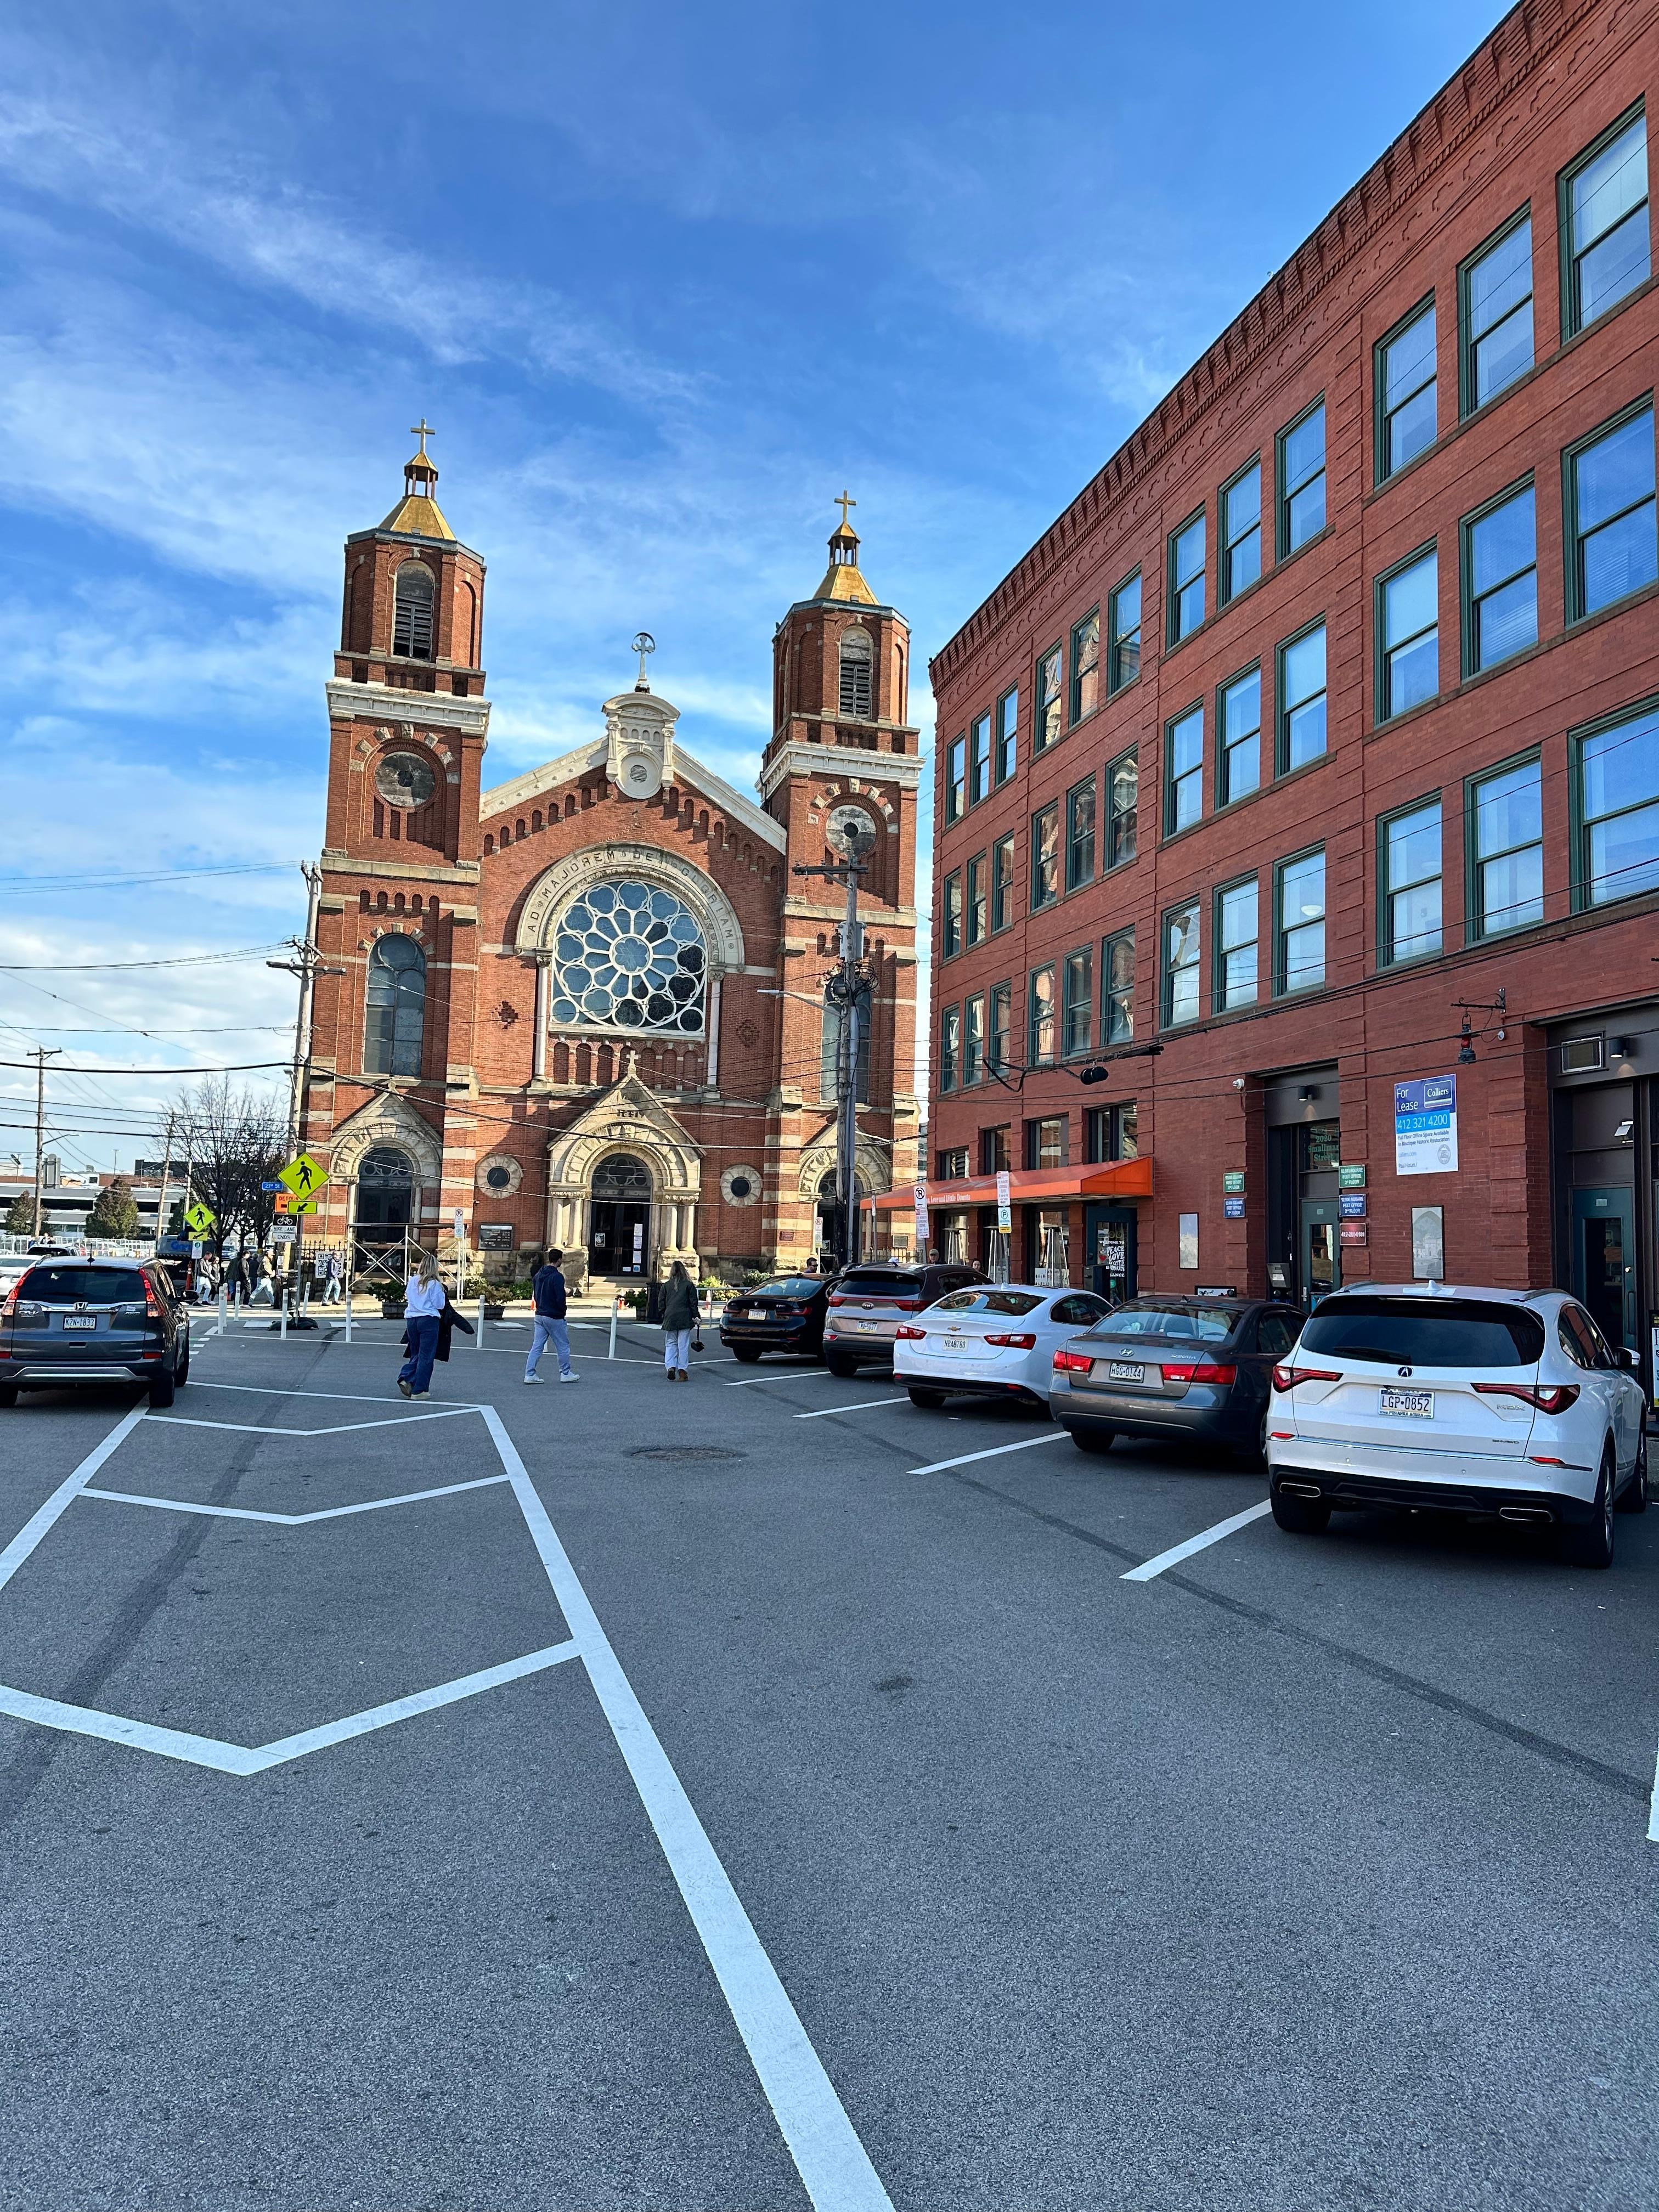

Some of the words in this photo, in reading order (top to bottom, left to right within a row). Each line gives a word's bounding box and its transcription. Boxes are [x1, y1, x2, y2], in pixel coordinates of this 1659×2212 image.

[1397, 1088, 1409, 1099] For
[1427, 1088, 1449, 1097] Colliers
[1397, 1102, 1418, 1112] Lease
[1398, 1119, 1411, 1130] 412
[1413, 1117, 1426, 1128] 321
[1428, 1114, 1448, 1126] 4200
[1107, 1246, 1125, 1257] PEACE
[1109, 1252, 1125, 1261] LOVE
